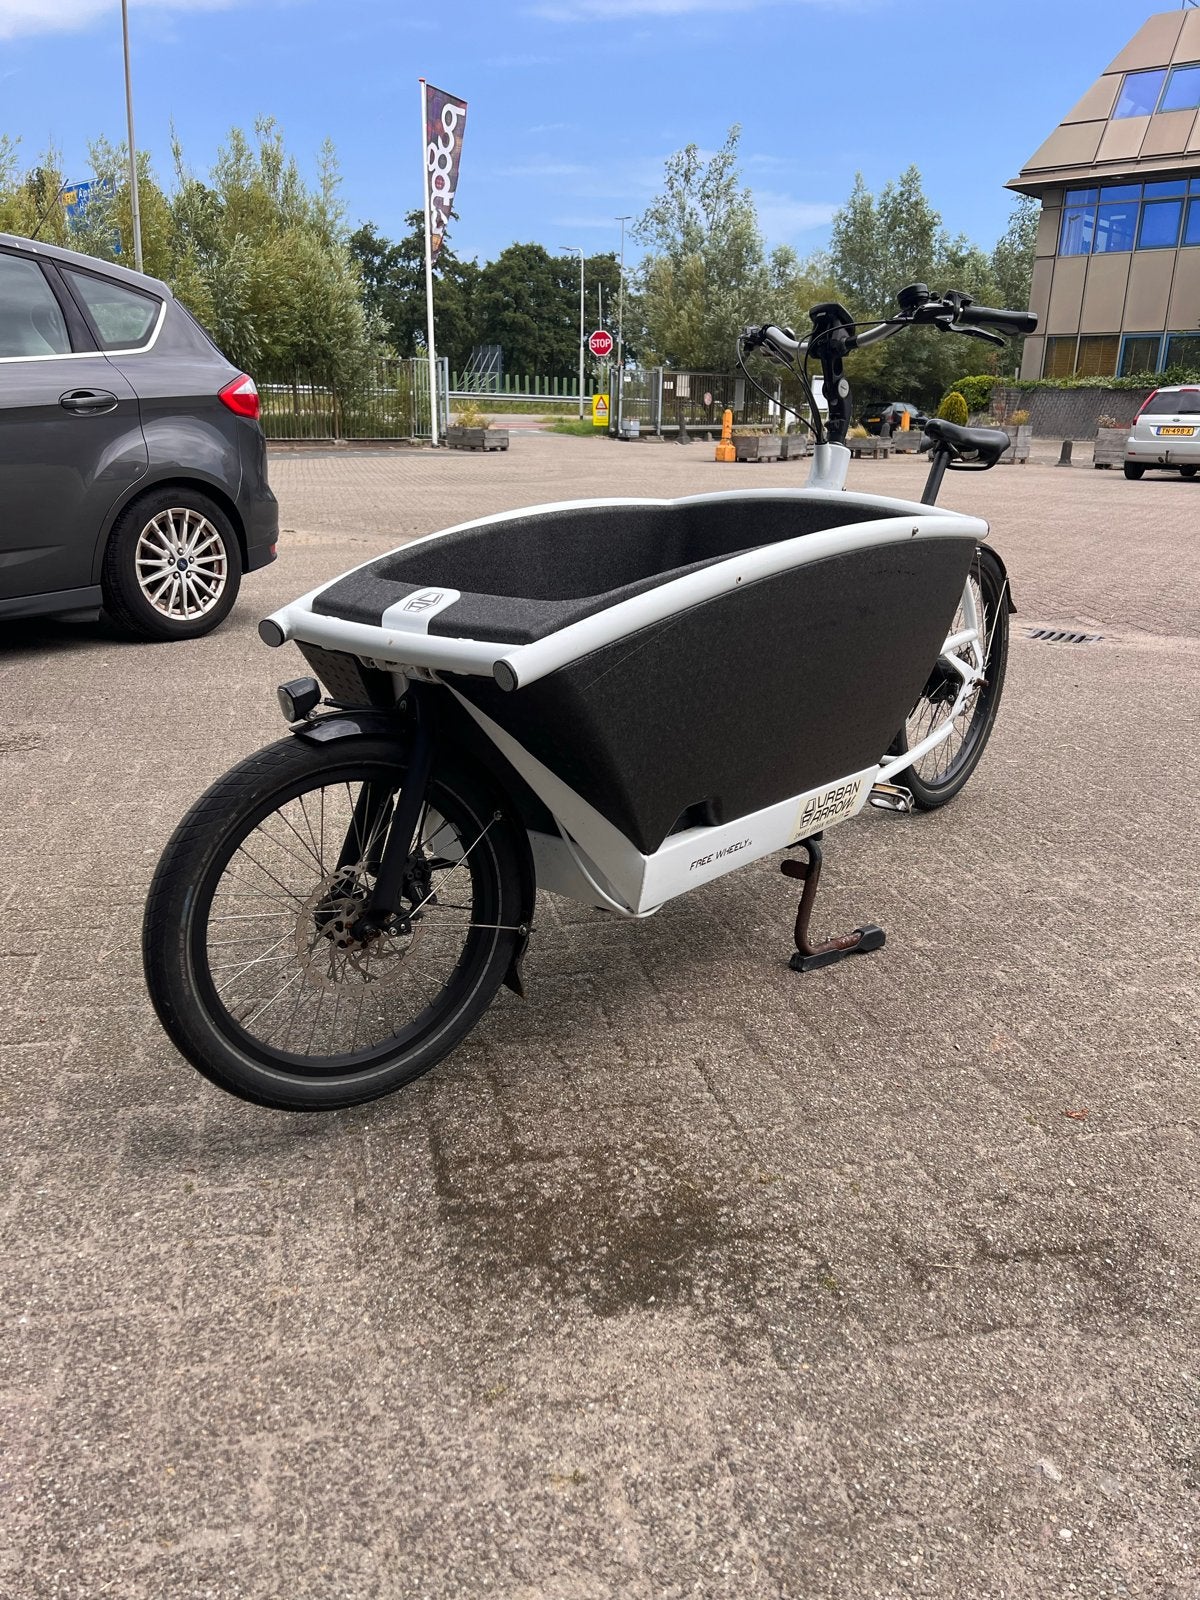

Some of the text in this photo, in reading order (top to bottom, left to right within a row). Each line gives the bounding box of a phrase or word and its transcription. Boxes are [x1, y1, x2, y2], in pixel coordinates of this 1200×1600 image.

[591, 338, 611, 349] STOP
[817, 779, 861, 809] URBAN
[809, 795, 857, 826] ARROW
[689, 853, 714, 871] FREE
